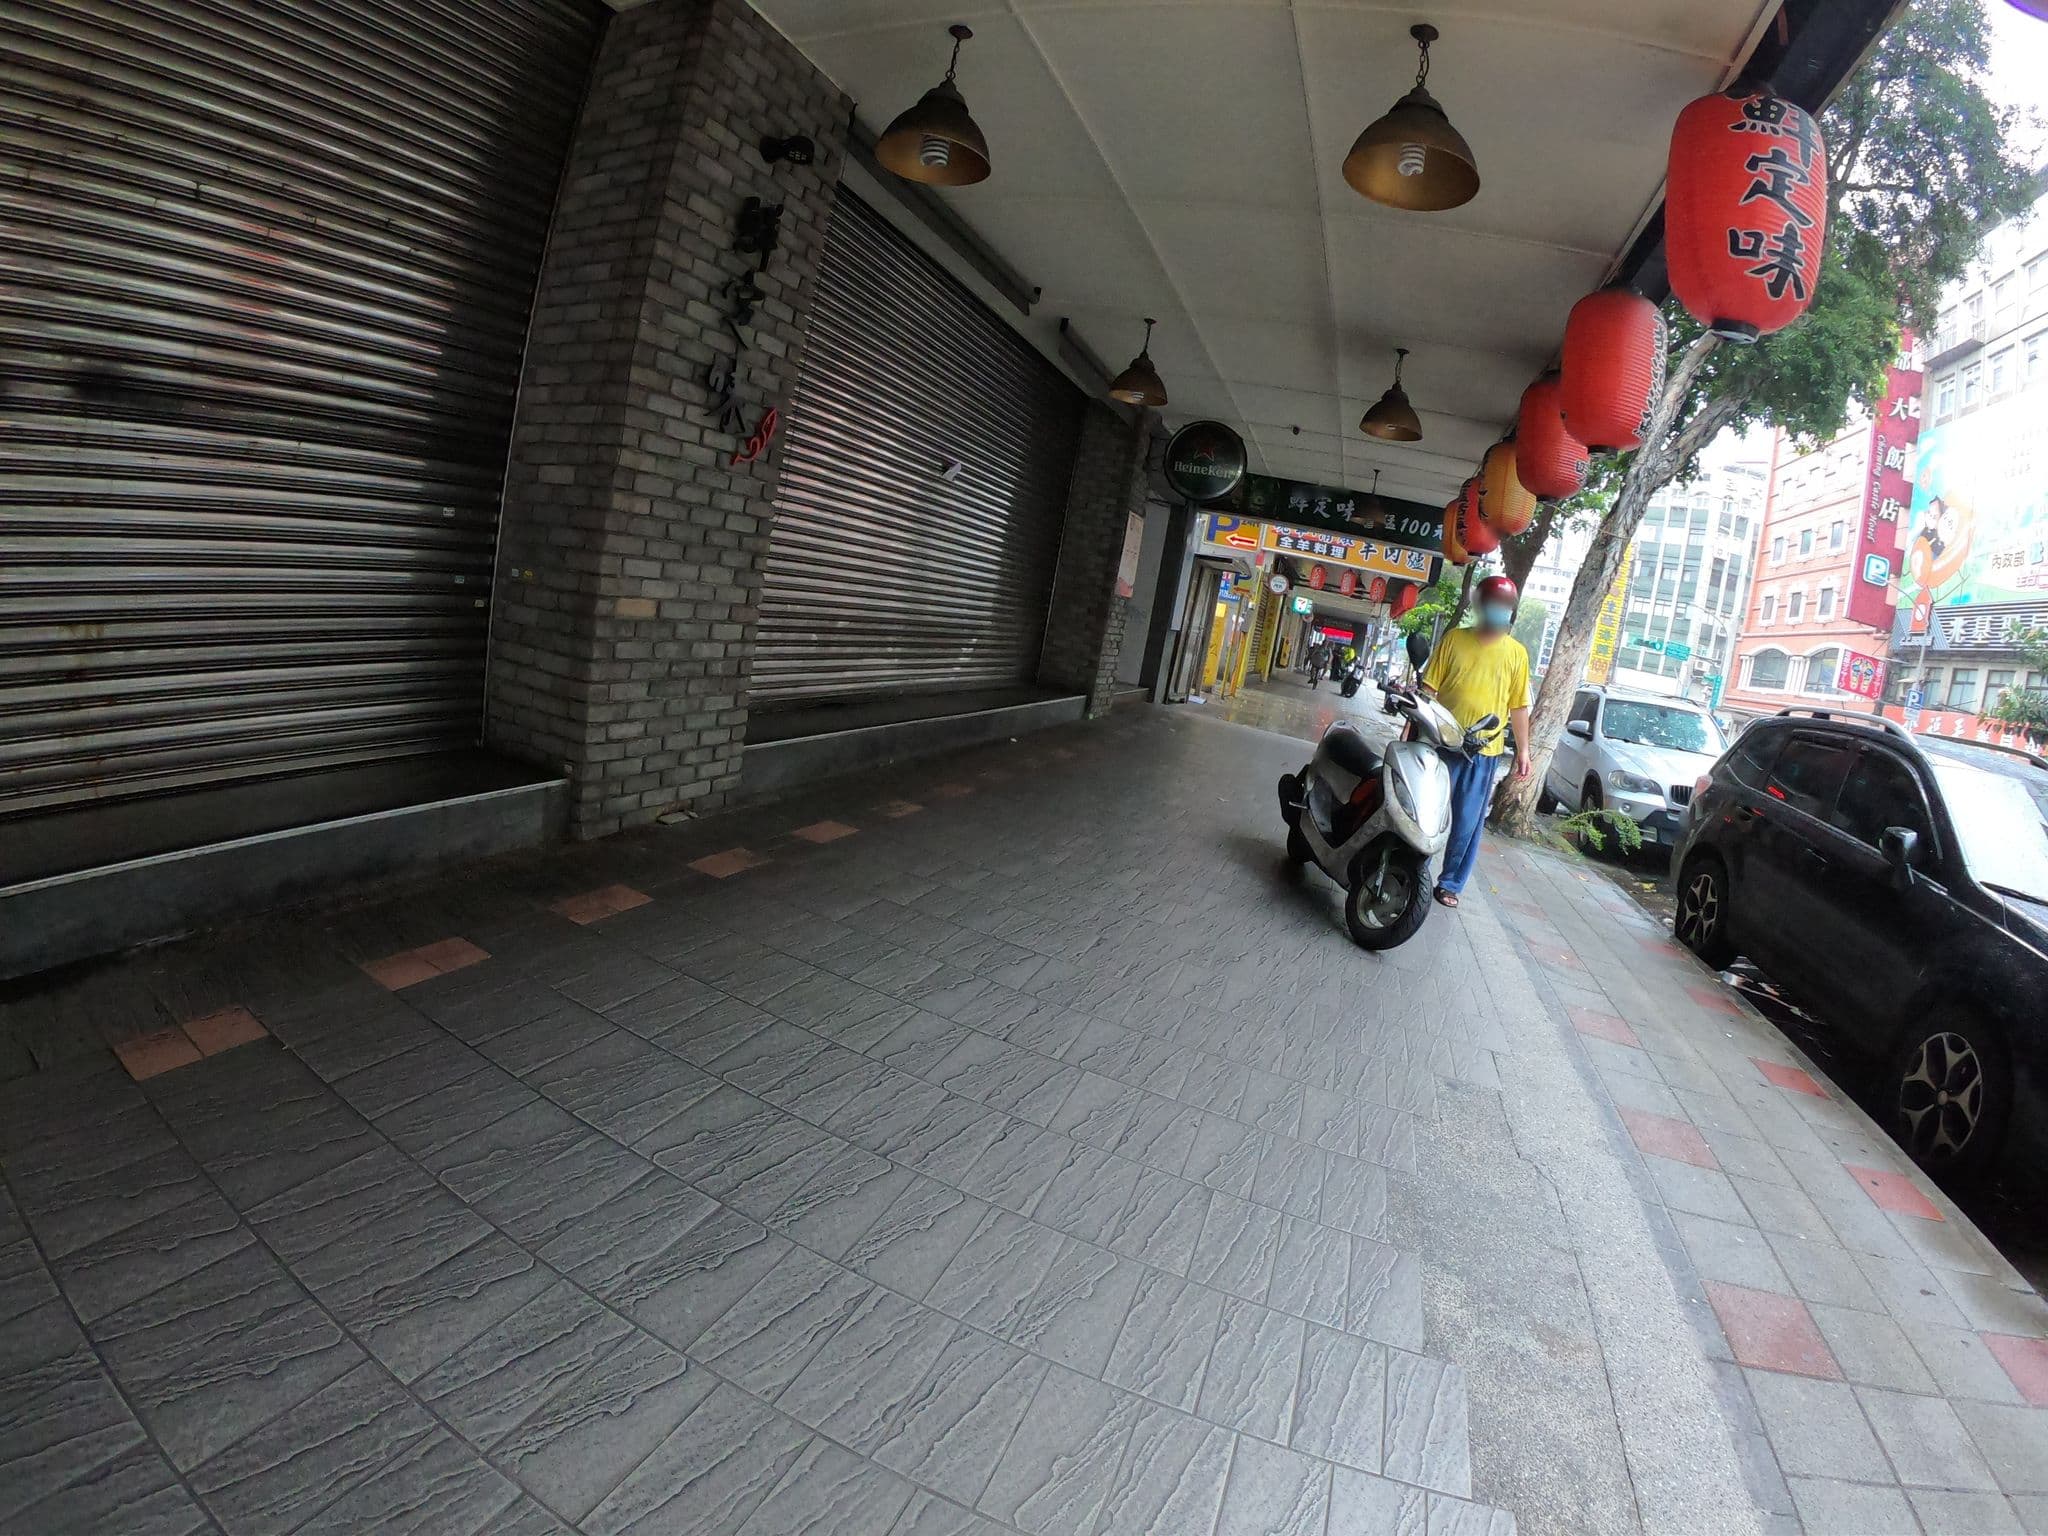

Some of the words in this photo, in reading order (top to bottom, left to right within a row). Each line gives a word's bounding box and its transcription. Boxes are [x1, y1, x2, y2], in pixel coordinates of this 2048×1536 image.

[1728, 91, 1822, 301] 鮮定味
[1174, 460, 1232, 479] Heineken
[1288, 495, 1356, 522] 鮮定味
[1207, 513, 1240, 541] P
[1279, 535, 1345, 559] 全羊料理
[1907, 691, 1919, 706] P
